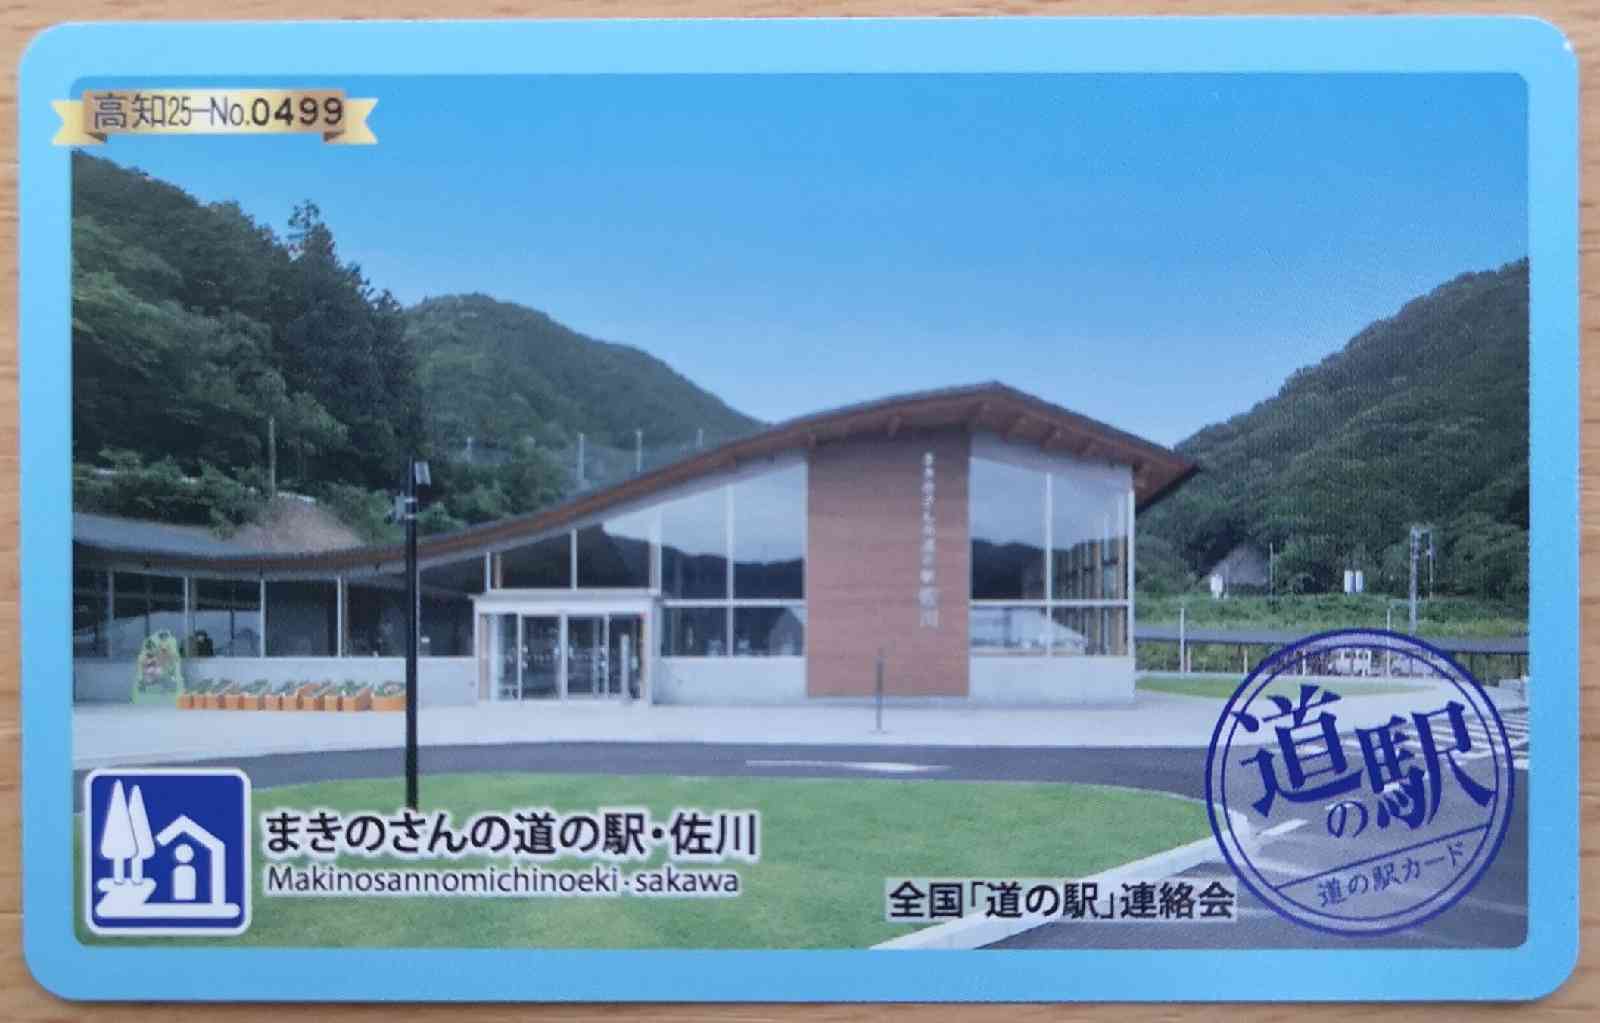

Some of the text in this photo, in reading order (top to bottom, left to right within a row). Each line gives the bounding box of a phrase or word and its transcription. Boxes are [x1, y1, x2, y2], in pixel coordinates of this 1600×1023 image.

[1230, 684, 1497, 839] 道の駅
[265, 812, 757, 856] まきのさんの道の駅・佐川
[888, 880, 1236, 920] 全国「道の駅」連絡会
[1317, 839, 1464, 907] 道の駅カード
